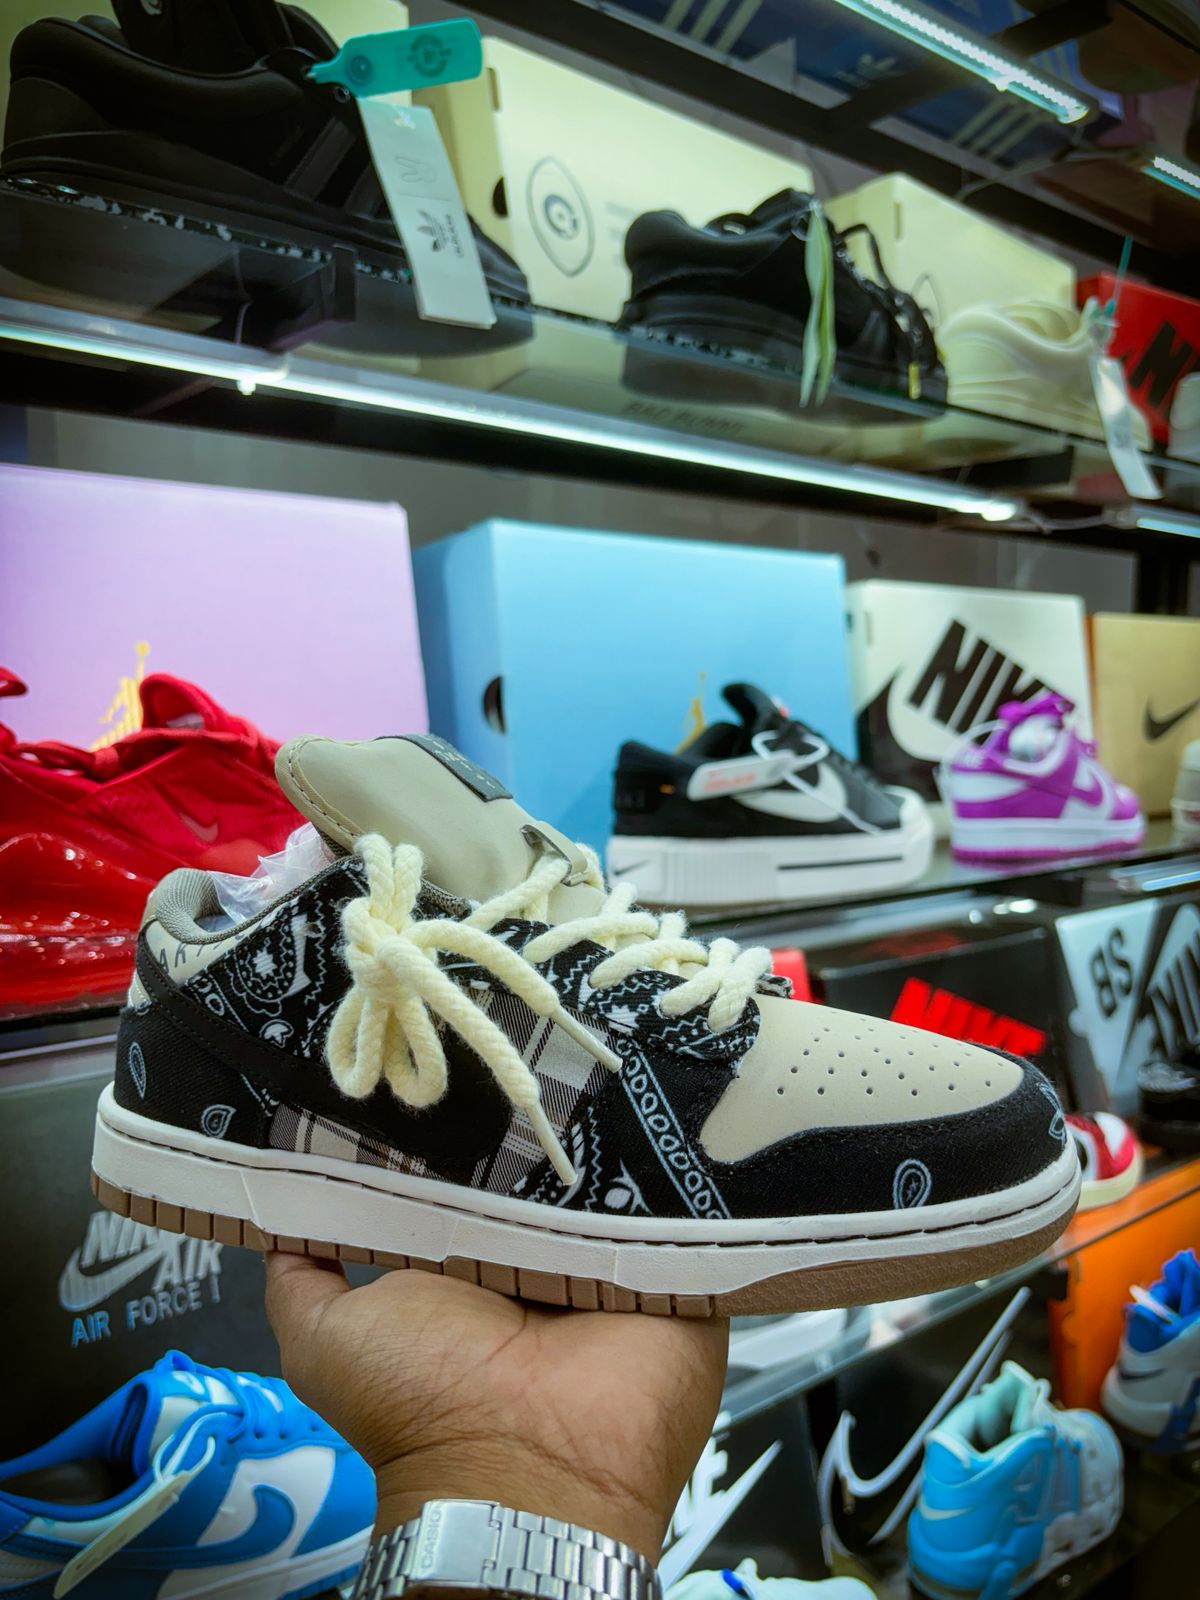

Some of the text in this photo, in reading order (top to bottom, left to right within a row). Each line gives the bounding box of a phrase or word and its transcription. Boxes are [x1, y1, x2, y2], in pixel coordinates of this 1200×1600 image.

[908, 620, 1076, 748] NIK
[80, 1210, 187, 1268] NIK
[71, 1311, 112, 1347] AIR
[126, 1282, 202, 1330] FORCE
[420, 1508, 442, 1569] CASIO
